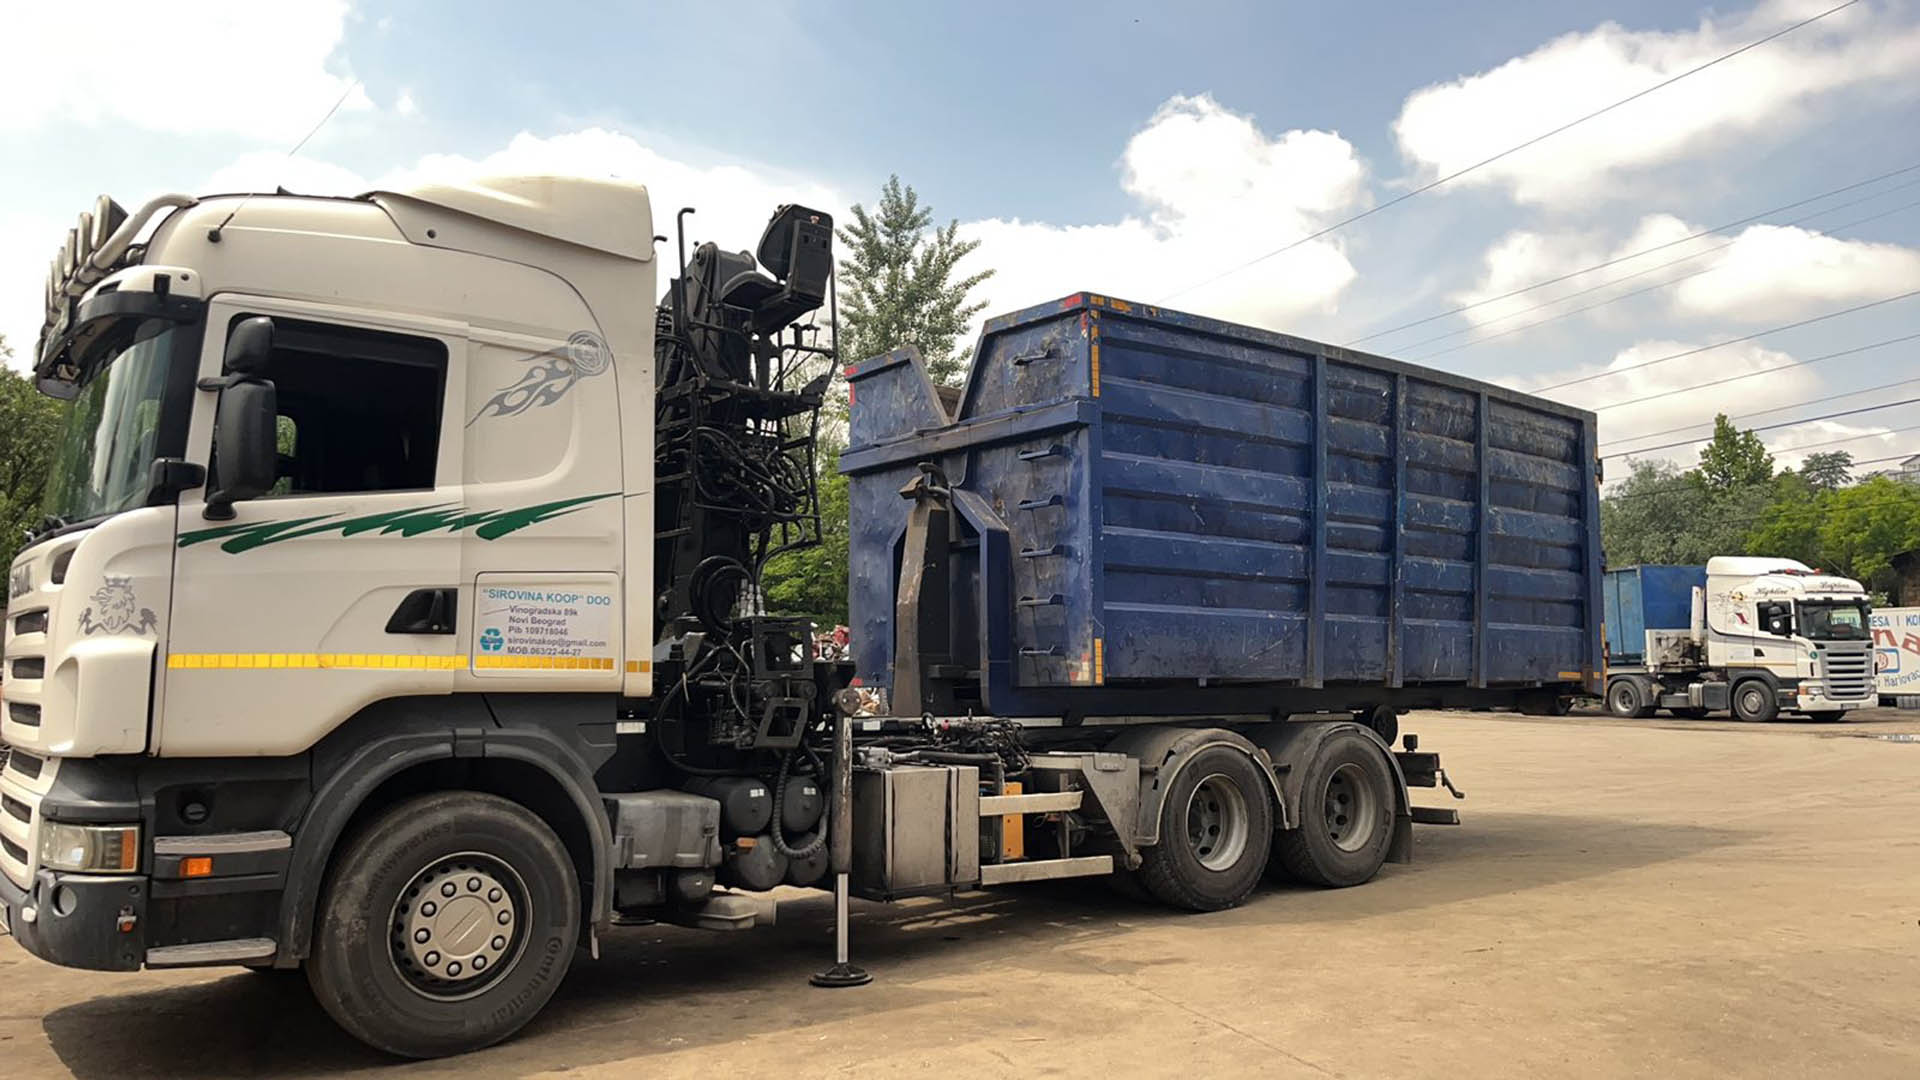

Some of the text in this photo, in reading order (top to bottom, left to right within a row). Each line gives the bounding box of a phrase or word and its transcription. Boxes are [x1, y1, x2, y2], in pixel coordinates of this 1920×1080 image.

[483, 588, 611, 605] "SIROVINA KOOP" DOO
[509, 605, 562, 616] Vinogradska
[509, 616, 567, 627] Novi Beograd
